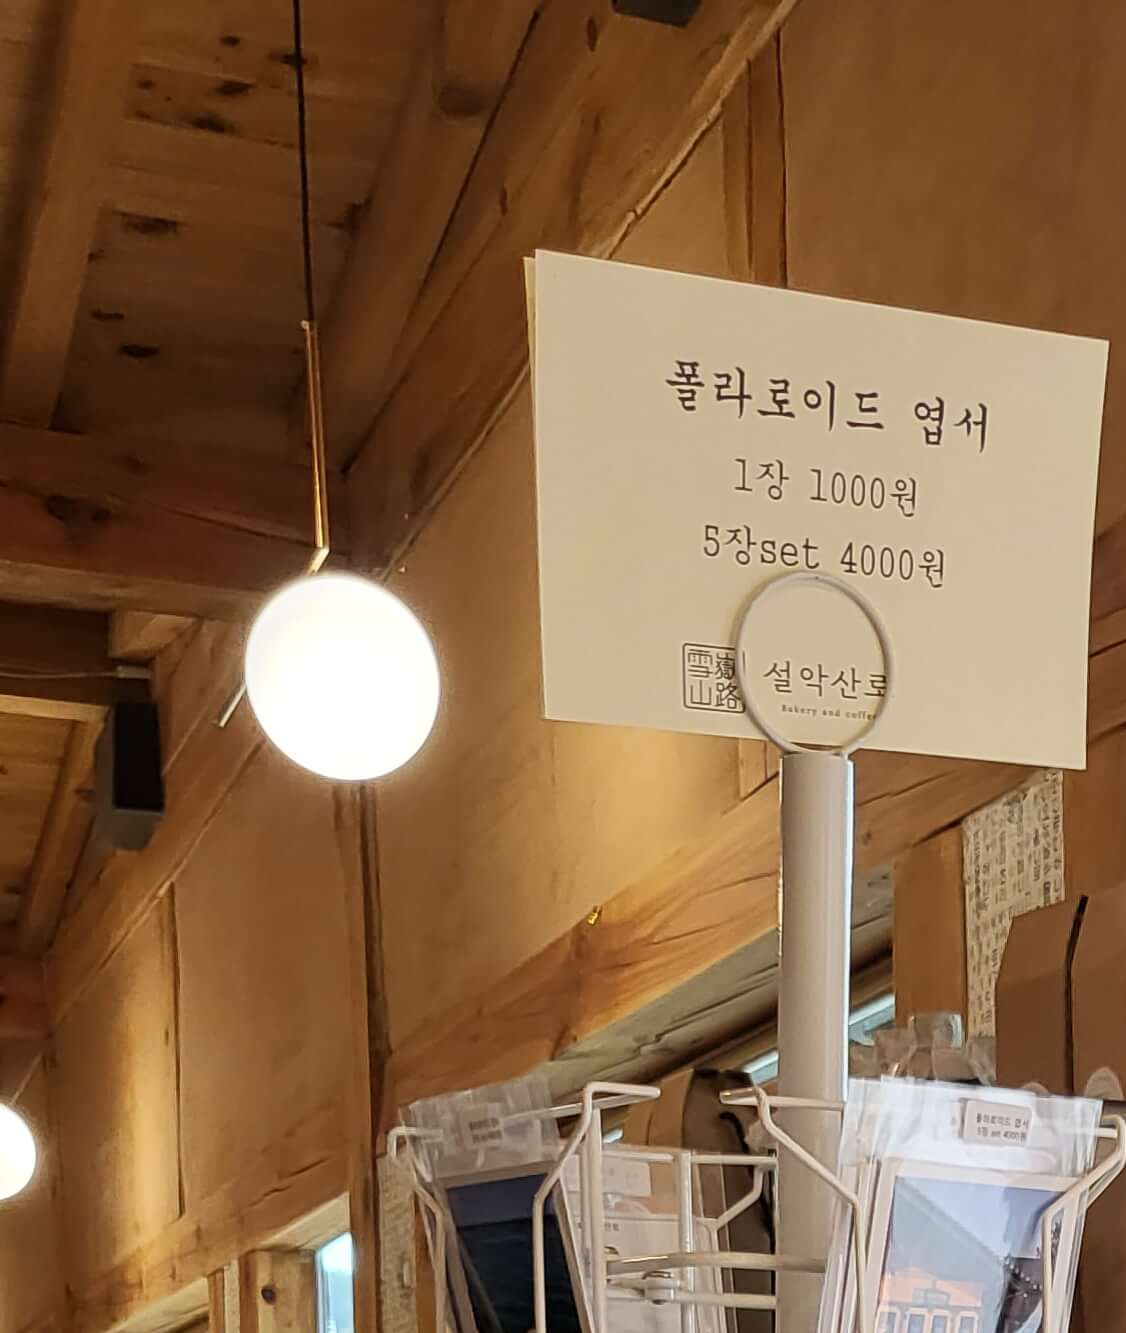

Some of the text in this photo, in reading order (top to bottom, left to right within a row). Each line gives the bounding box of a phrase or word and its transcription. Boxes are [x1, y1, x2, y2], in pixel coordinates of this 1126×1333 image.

[665, 359, 988, 453] 폴라로이드 엽서
[734, 458, 918, 518] 1장 1000원
[703, 525, 945, 589] 5장set 4000원
[763, 660, 888, 700] 설악산로
[781, 704, 817, 716] Bakery
[822, 708, 841, 717] and
